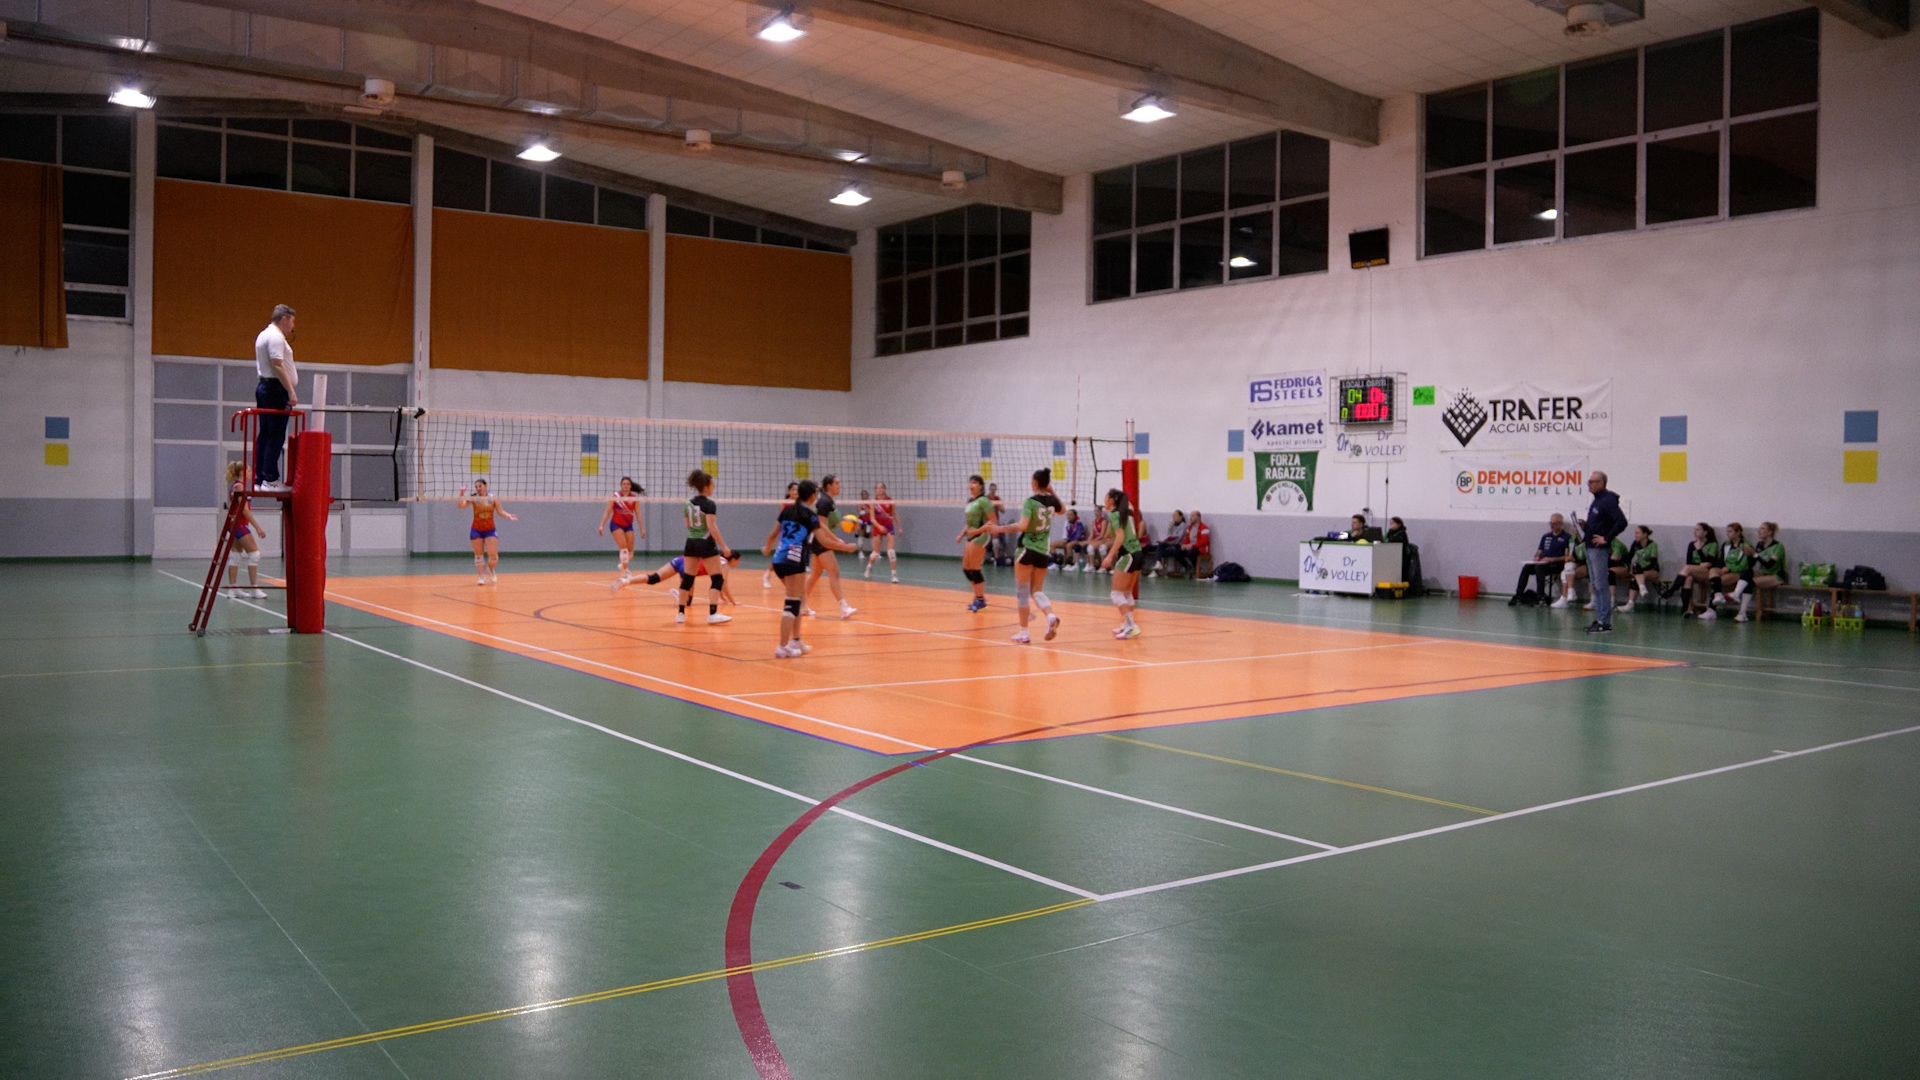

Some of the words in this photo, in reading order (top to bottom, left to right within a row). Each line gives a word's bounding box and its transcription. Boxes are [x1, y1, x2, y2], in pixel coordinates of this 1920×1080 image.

[1274, 375, 1322, 390] FEDRIGA
[1274, 386, 1323, 401] STEELS
[1347, 388, 1363, 404] 04
[1488, 396, 1583, 421] TRAFER
[1585, 410, 1609, 421] s.p.a.
[1266, 418, 1324, 436] kamet
[1488, 422, 1530, 434] ACCIAI
[1533, 421, 1583, 433] SPECIALI
[1377, 429, 1392, 441] Dr
[1267, 439, 1292, 447] special
[1294, 438, 1323, 446] profiles
[1365, 444, 1405, 456] VOLLEY
[1270, 453, 1301, 466] FORZA
[1265, 466, 1307, 480] RAGAZZE
[1477, 470, 1582, 486] DEMOLIZIONI
[1459, 476, 1473, 487] BP
[1477, 485, 1582, 495] BONOMELLI
[687, 505, 702, 527] 13
[782, 522, 800, 539] 52
[1342, 556, 1358, 567] Dr
[1331, 568, 1369, 582] VOLLEY
